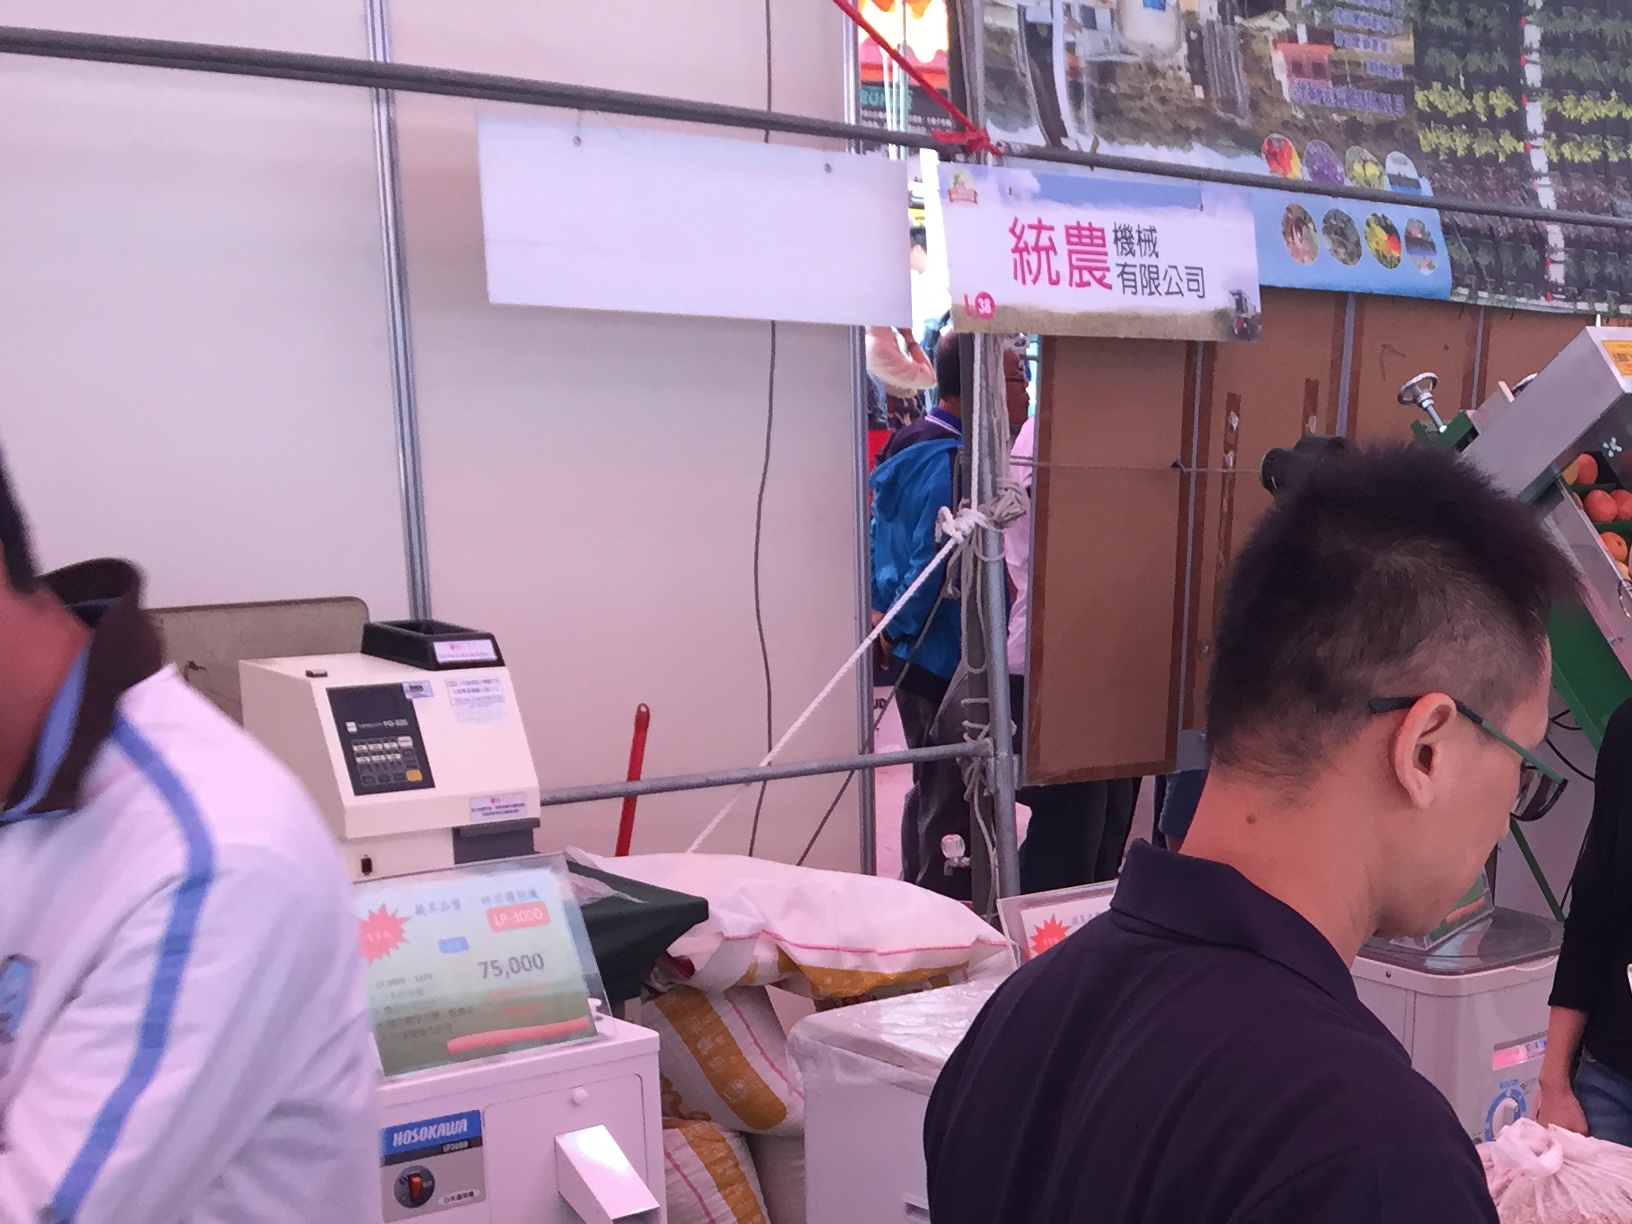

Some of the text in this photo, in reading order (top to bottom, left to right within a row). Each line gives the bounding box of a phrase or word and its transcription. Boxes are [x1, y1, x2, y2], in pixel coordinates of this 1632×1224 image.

[1008, 216, 1113, 290] 統農
[1112, 222, 1159, 259] 機械
[1115, 261, 1206, 299] 有限公司
[977, 298, 992, 314] 38
[477, 953, 545, 979] 75,000
[392, 1118, 468, 1147] HOSOKAWA
